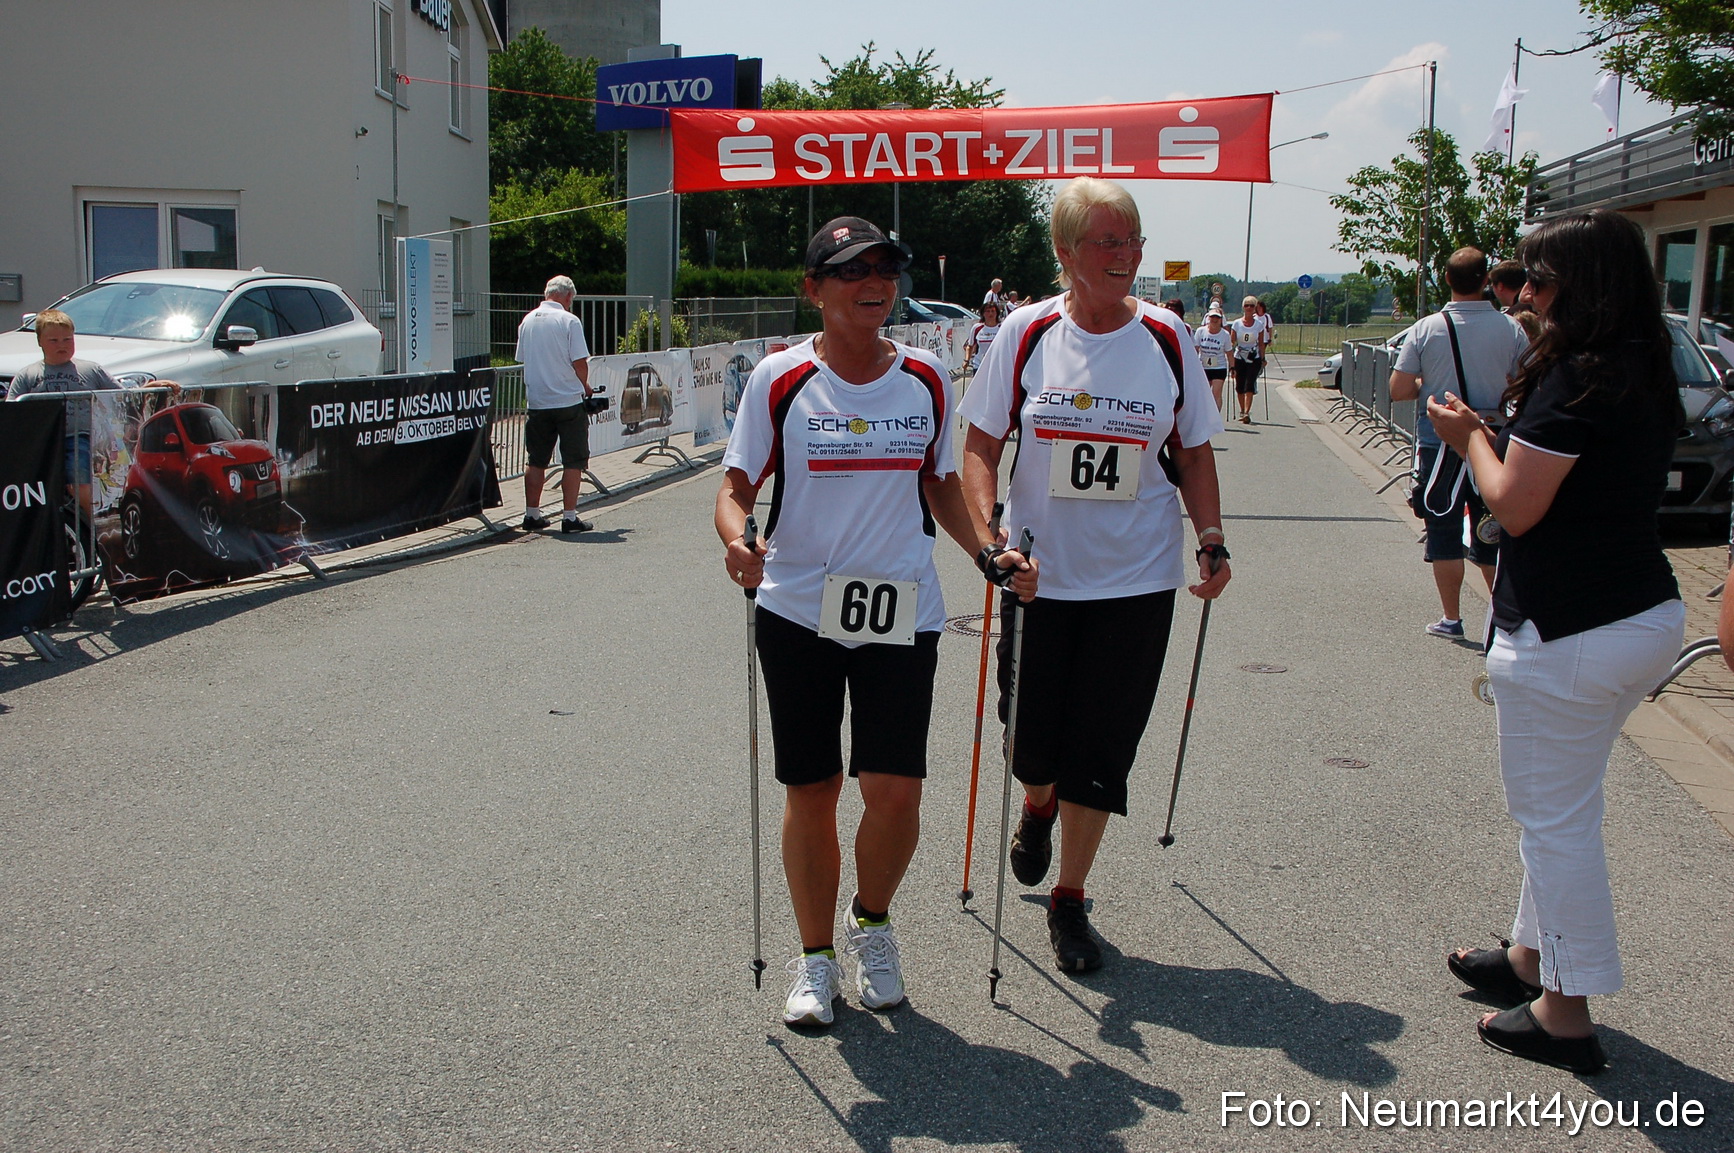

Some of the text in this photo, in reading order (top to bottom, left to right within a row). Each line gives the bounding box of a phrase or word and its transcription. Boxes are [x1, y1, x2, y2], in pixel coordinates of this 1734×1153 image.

[608, 77, 713, 107] VOLVO
[1244, 333, 1250, 342] 6
[1207, 358, 1212, 366] 4
[311, 387, 491, 428] DER NEUE NISSAN JUKE
[1032, 414, 1073, 422] Regensburger
[356, 431, 371, 446] AB
[374, 428, 394, 444] DEM
[408, 420, 455, 438] OKTOBER
[1126, 421, 1153, 431] Neumarkt
[1071, 443, 1120, 491] 64
[2, 481, 46, 510] ON
[840, 580, 898, 635] 60
